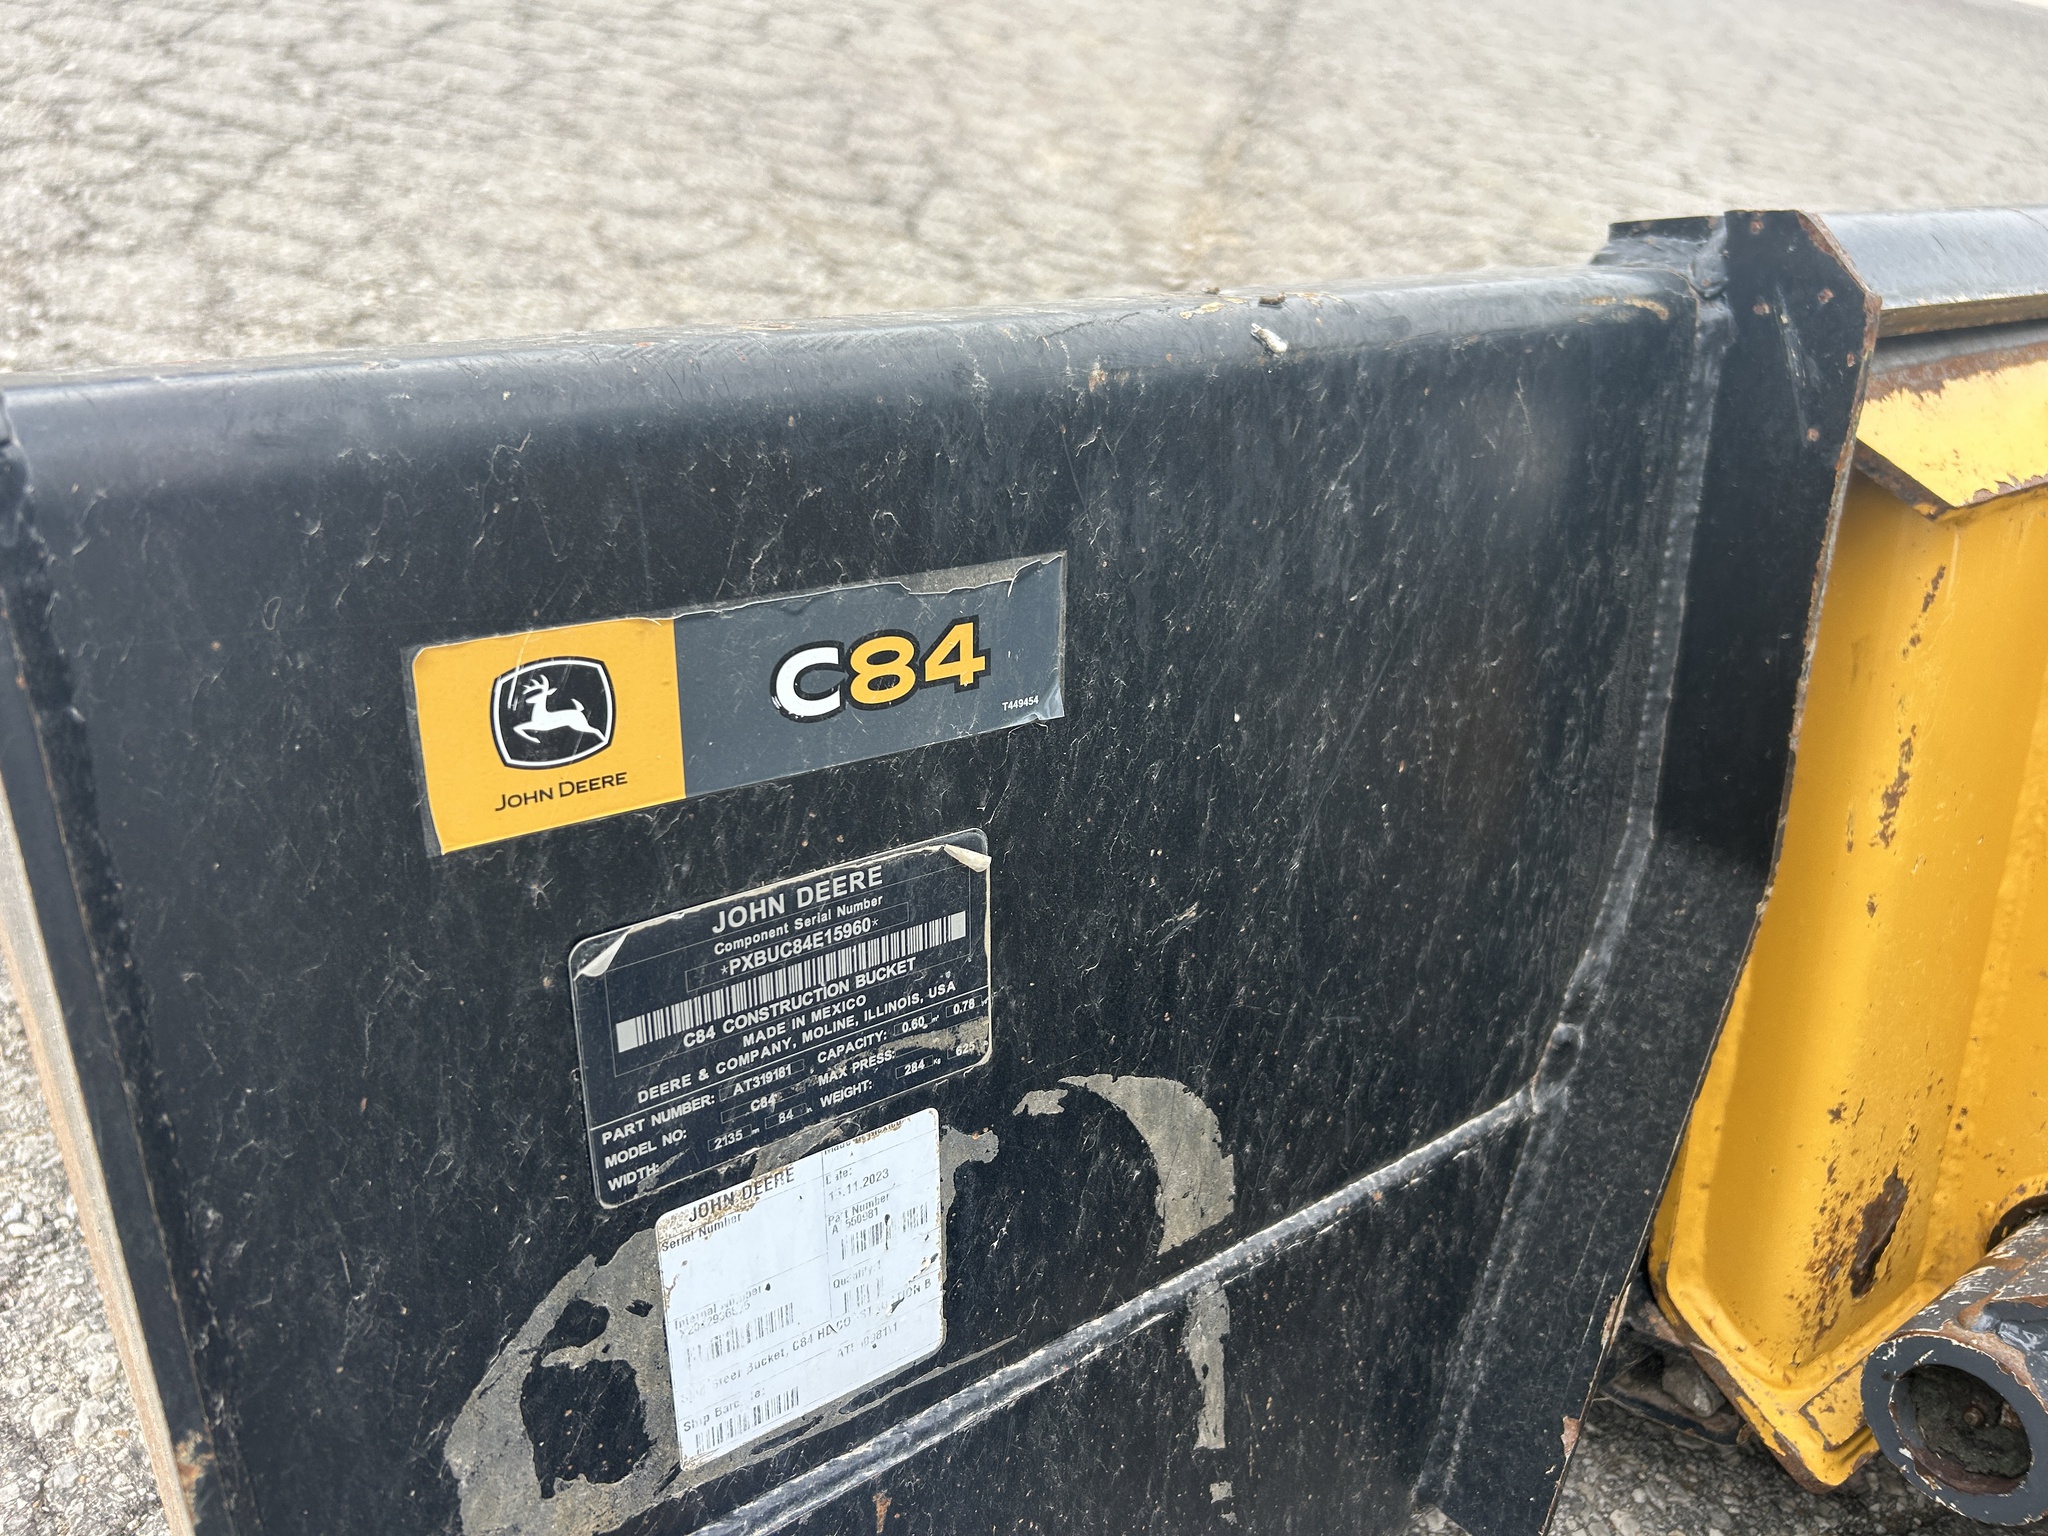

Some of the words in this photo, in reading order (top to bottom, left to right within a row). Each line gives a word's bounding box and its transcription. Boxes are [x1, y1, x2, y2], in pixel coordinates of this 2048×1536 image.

[771, 616, 988, 721] C84
[1002, 694, 1039, 712] T449454
[712, 894, 785, 934] JOHN
[797, 865, 883, 909] DEERE
[714, 923, 789, 955] Component
[794, 909, 832, 930] Serial
[837, 895, 883, 918] Number
[683, 1024, 716, 1048] C84
[722, 979, 850, 1034] CONSTRUCTION
[855, 957, 917, 989] BUCKET
[742, 1022, 786, 1047] MADE
[792, 1015, 806, 1030] IN
[811, 994, 867, 1023] MEXICO
[817, 1030, 887, 1064] CAPACITY:
[901, 1016, 926, 1034] 0.60
[953, 998, 976, 1015] 0.78
[637, 1073, 692, 1104] DEERE
[698, 1068, 710, 1081] &
[715, 1037, 797, 1075] COMPANY,
[802, 1015, 859, 1044] MOLINE,
[863, 992, 924, 1022] ILLINOIS,
[928, 980, 956, 999] USA
[818, 1066, 848, 1087] MAX
[852, 1050, 896, 1074] PRESS:
[820, 1079, 873, 1108] WEIGHT:
[904, 1058, 926, 1076] 284
[955, 1042, 976, 1057] 625
[602, 1119, 645, 1145] PART
[651, 1093, 715, 1127] NUMBER:
[732, 1063, 792, 1096] AT319181
[604, 1140, 657, 1169] MODEL
[662, 1129, 687, 1147] NO:
[750, 1093, 776, 1112] C84
[607, 1162, 660, 1192] WIDTH:
[714, 1129, 743, 1150] 2135
[778, 1109, 794, 1124] 84
[688, 1191, 736, 1223] JOHN
[742, 1166, 795, 1201] DEERE
[852, 1193, 890, 1216] Number
